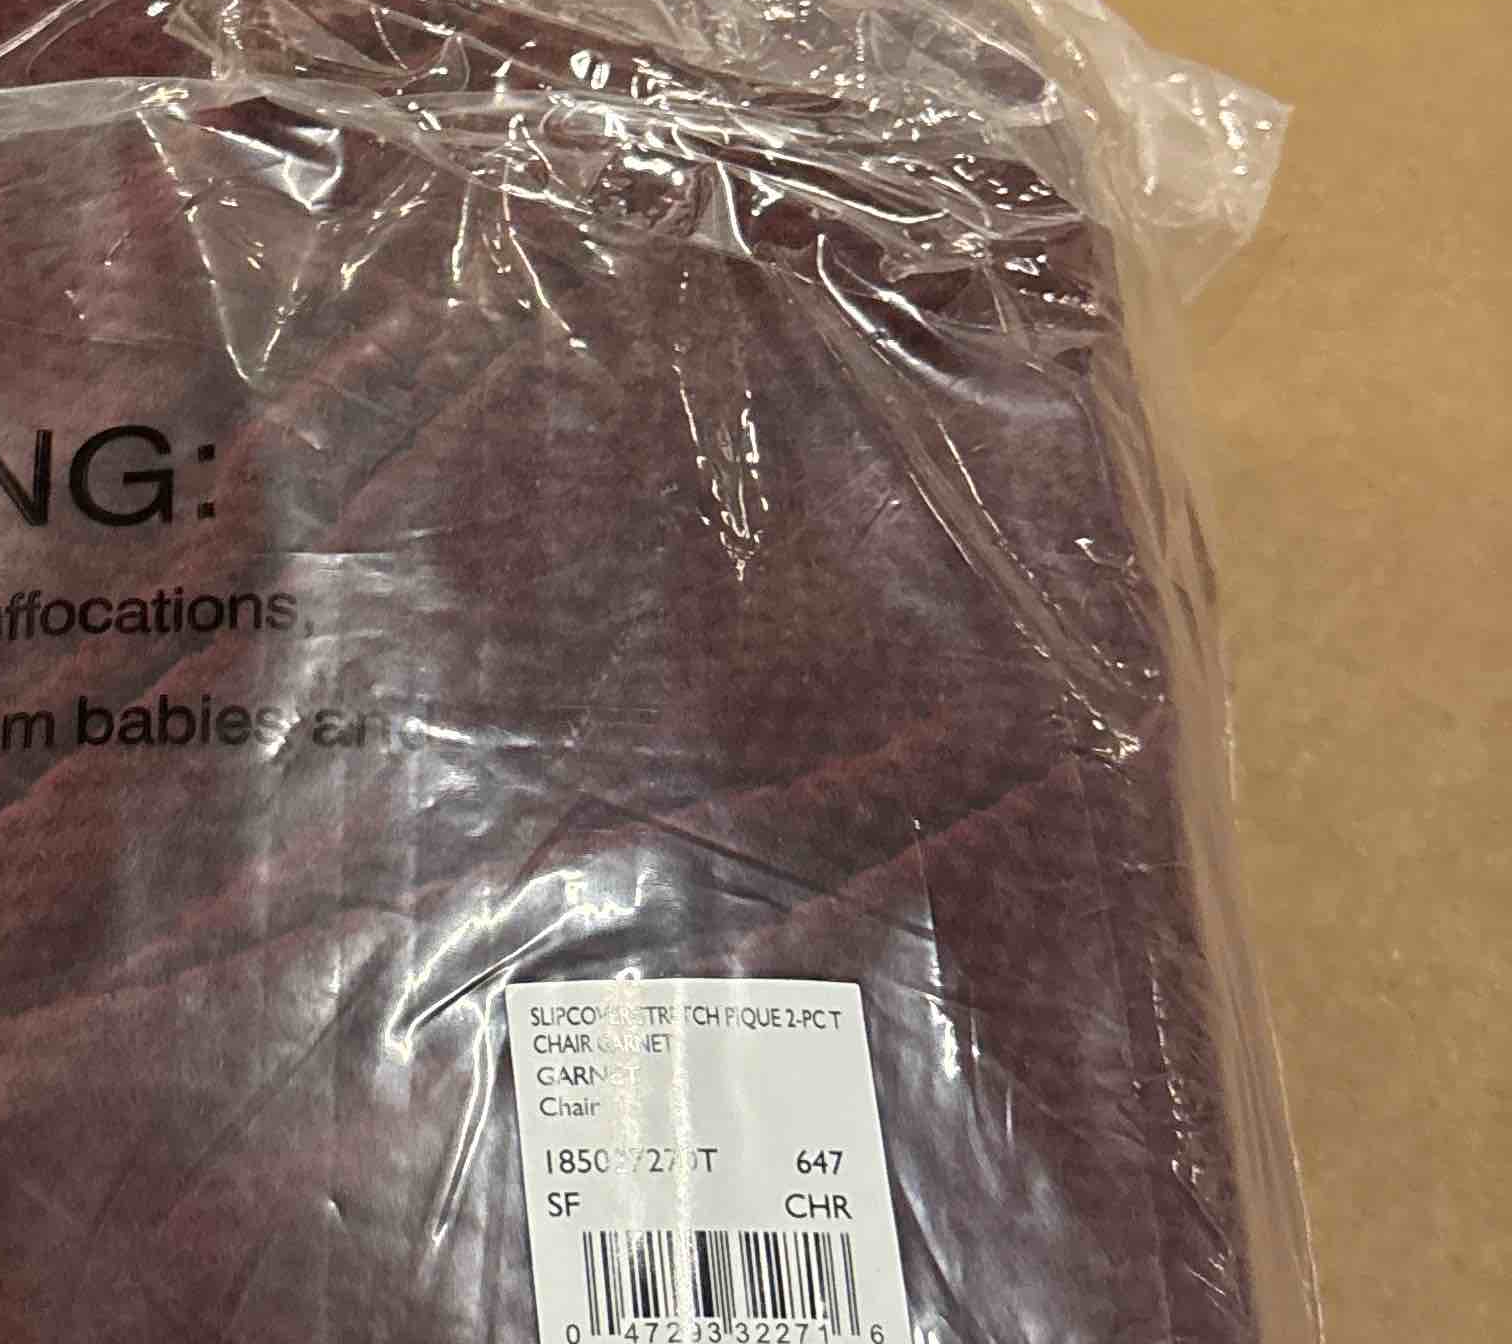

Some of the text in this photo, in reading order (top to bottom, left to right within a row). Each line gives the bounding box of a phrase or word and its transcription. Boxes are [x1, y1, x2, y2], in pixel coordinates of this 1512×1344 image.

[77, 696, 288, 750] babies
[533, 1033, 593, 1054] CHAIR
[538, 1096, 601, 1118] Chair
[795, 1149, 844, 1176] 647
[547, 1191, 853, 1220] SF CHR
